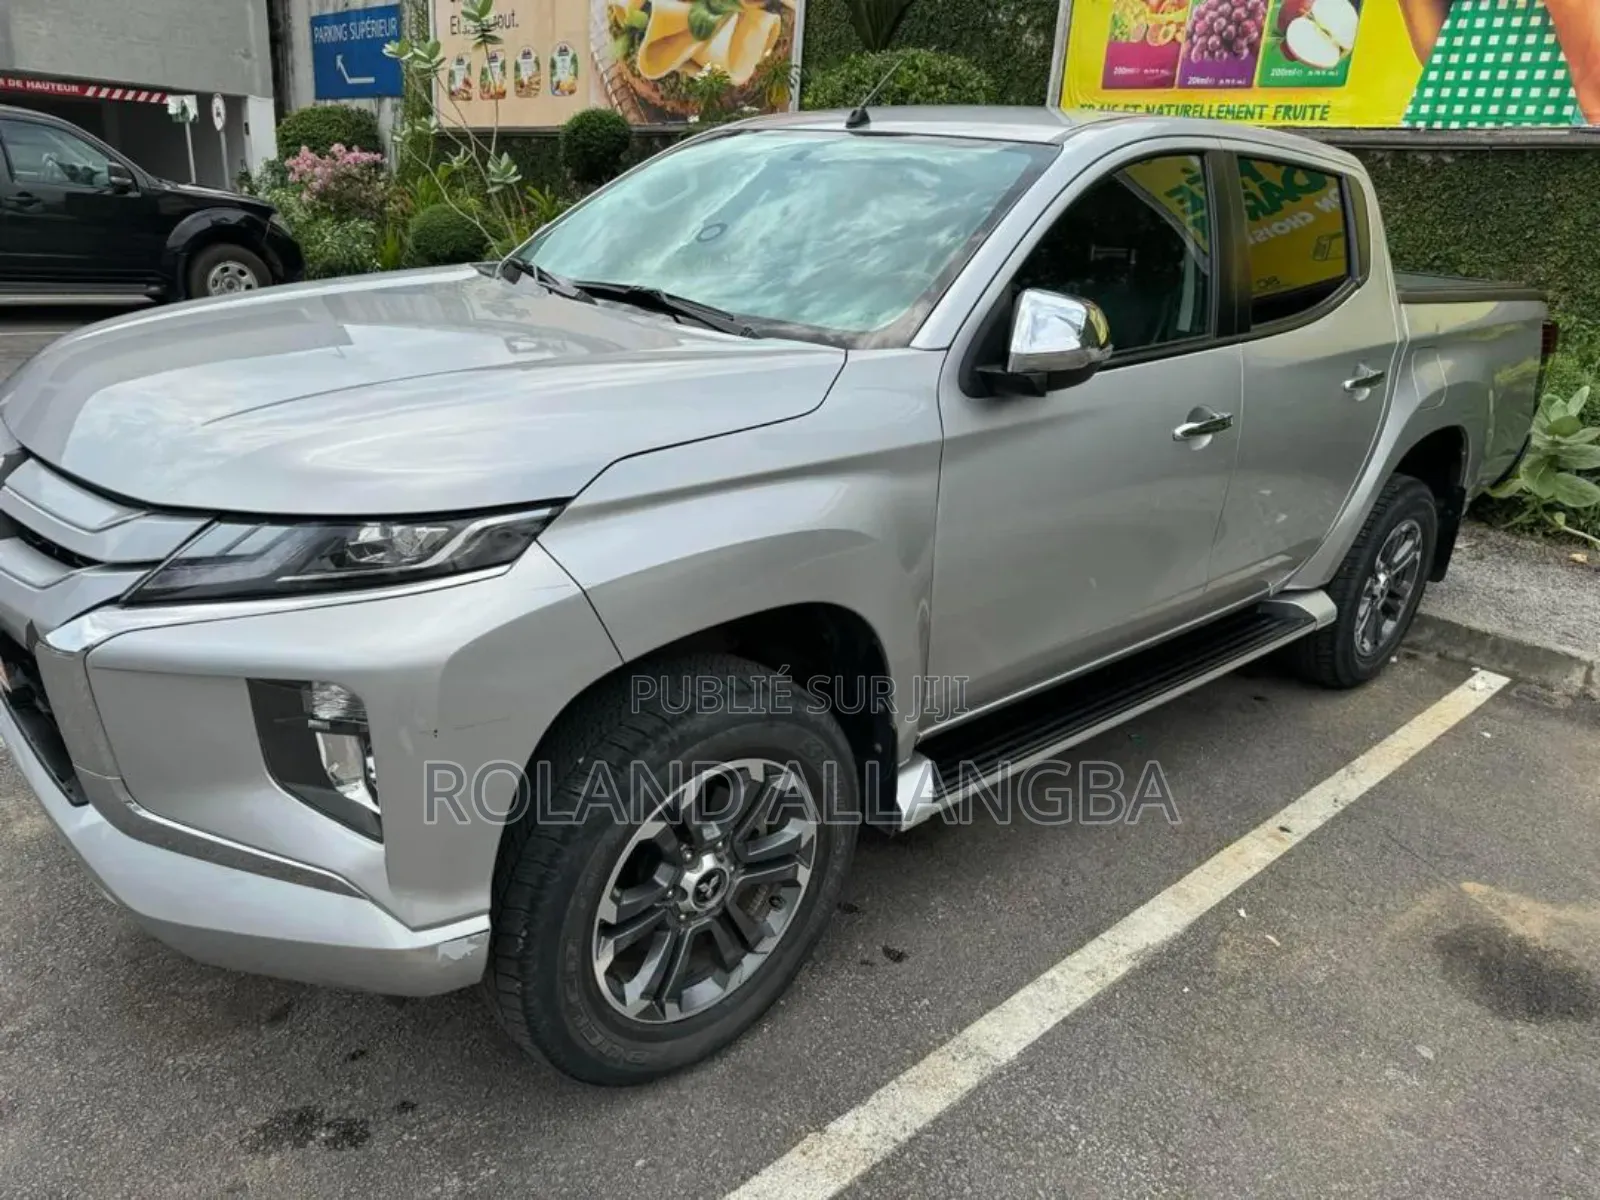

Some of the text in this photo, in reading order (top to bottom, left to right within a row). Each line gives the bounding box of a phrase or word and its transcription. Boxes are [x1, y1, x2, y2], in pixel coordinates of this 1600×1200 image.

[313, 16, 398, 44] PARKING SUPÉRIEUR
[8, 79, 23, 88] DE
[26, 80, 79, 93] HAUTEUR
[1145, 103, 1268, 119] NATURELLEMENT
[1272, 100, 1331, 121] FRUITÉ
